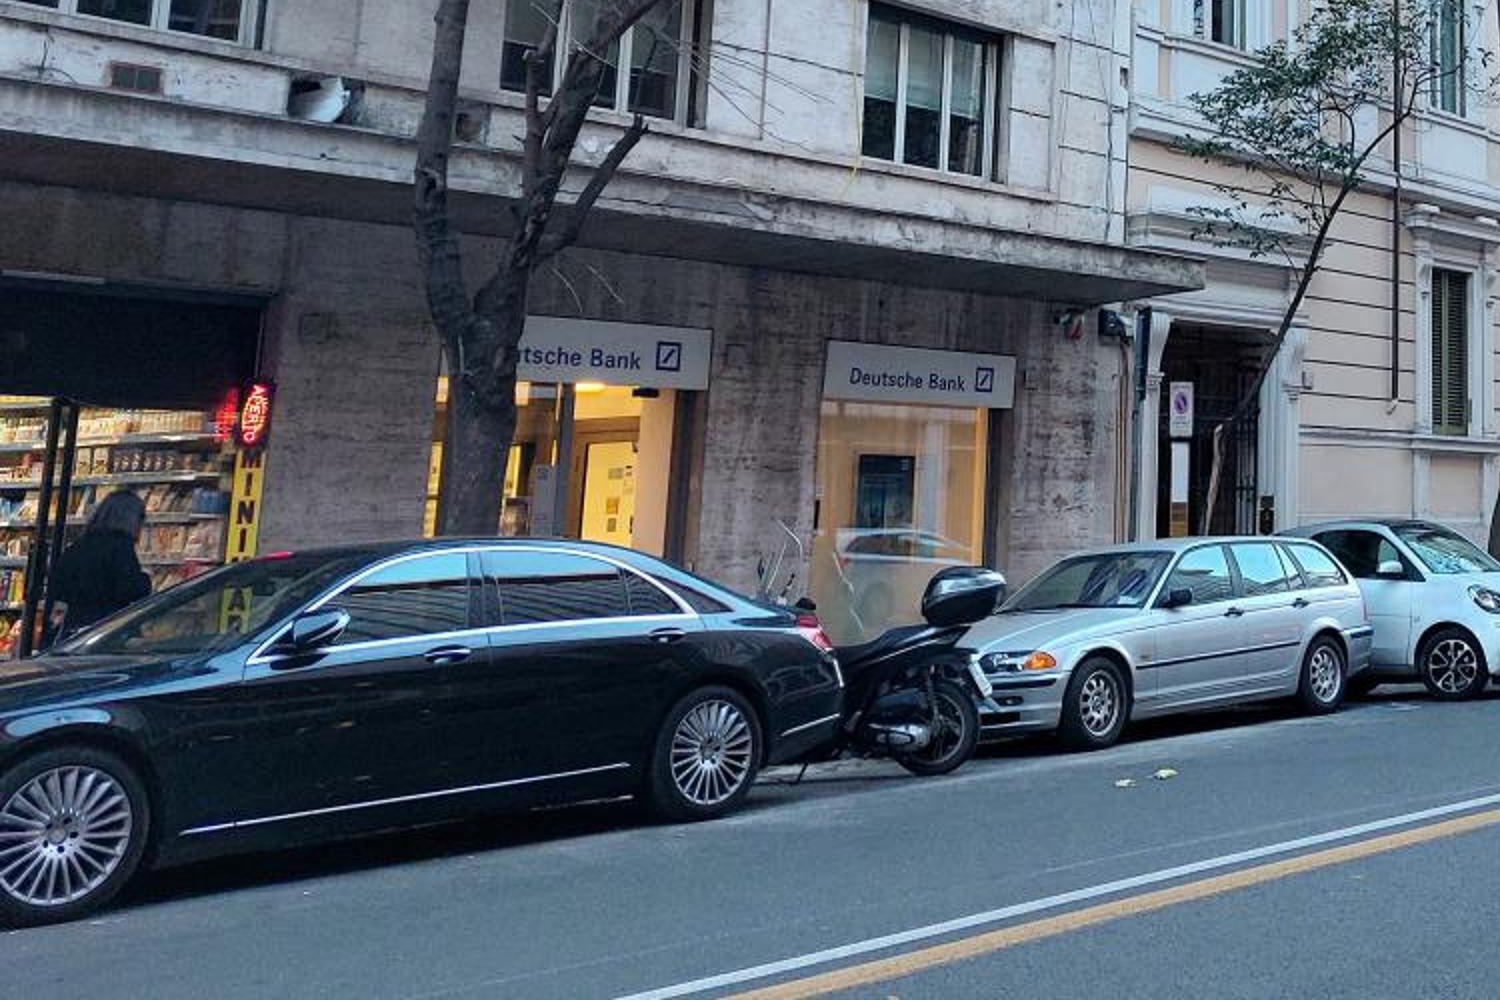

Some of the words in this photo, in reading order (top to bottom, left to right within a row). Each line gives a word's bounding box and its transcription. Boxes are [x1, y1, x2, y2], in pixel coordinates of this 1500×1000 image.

[516, 346, 581, 367] tsche
[590, 349, 641, 370] Bank
[850, 367, 923, 389] Deutsche
[929, 373, 965, 392] Bank
[236, 452, 261, 553] MINI
